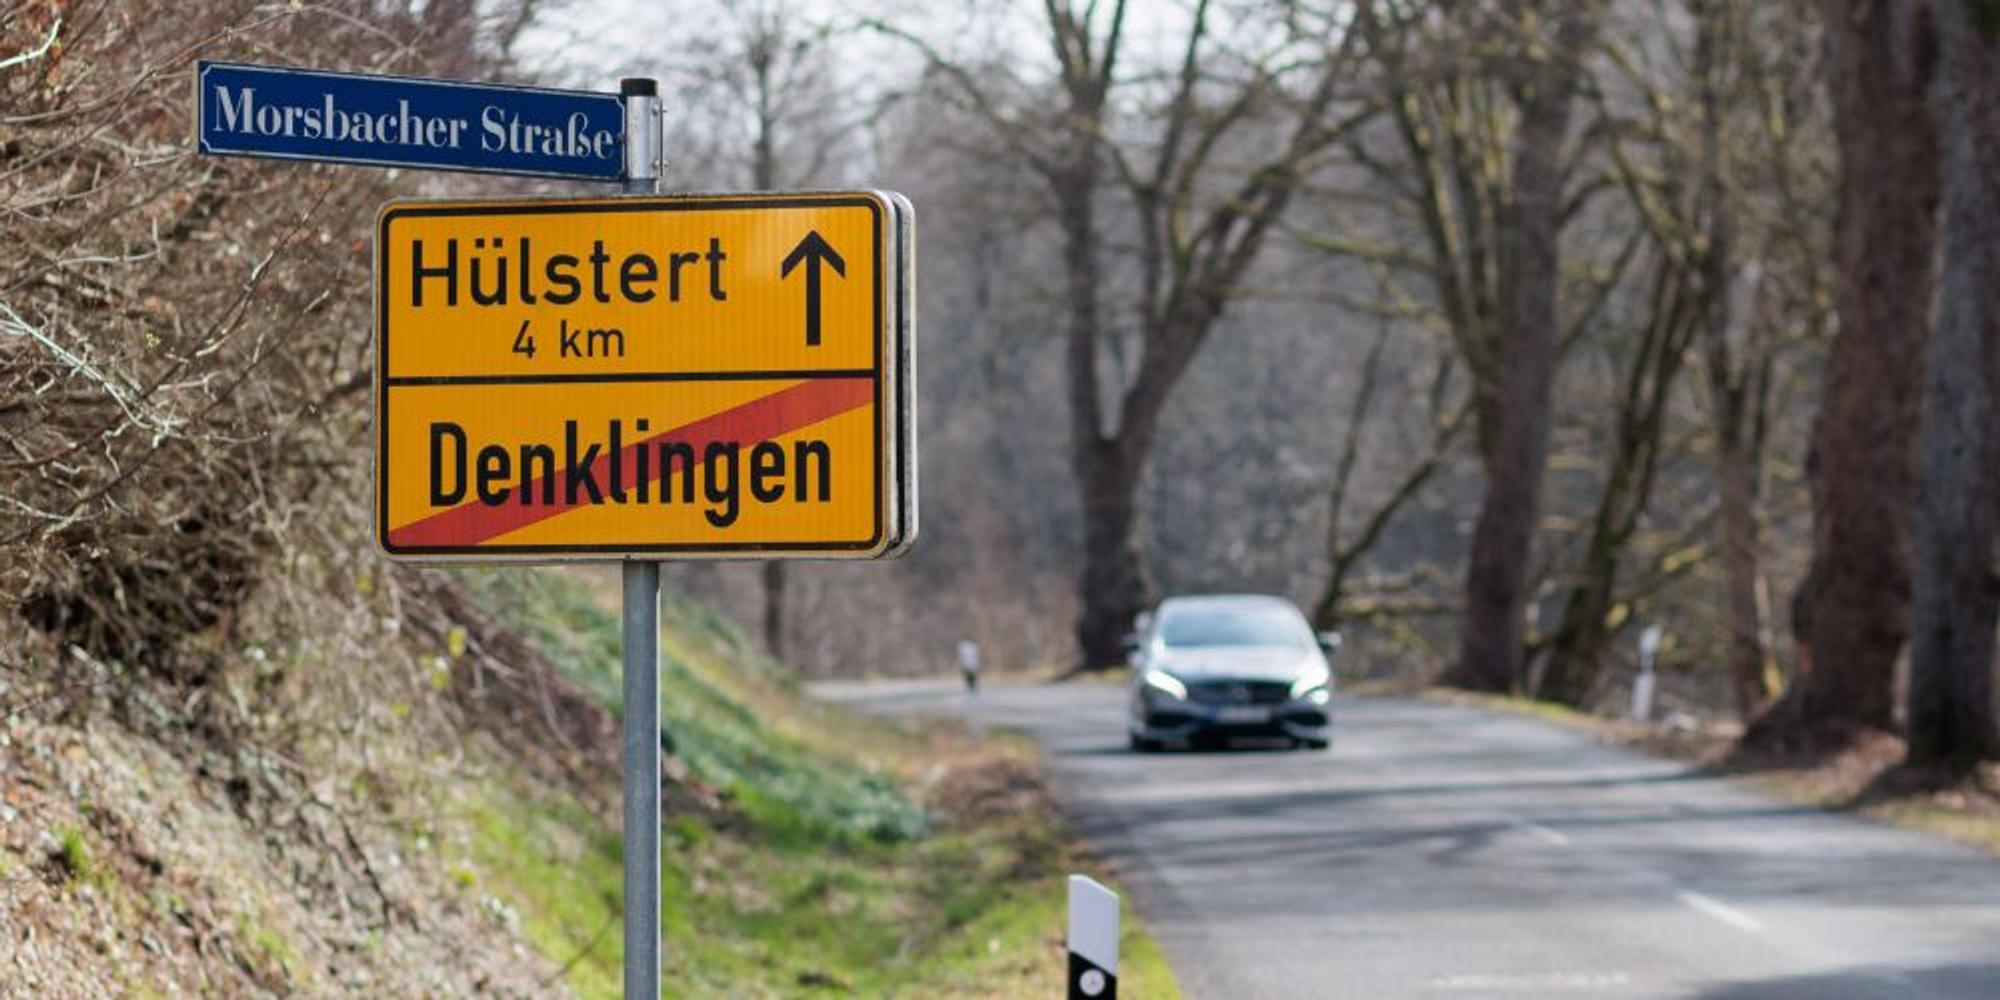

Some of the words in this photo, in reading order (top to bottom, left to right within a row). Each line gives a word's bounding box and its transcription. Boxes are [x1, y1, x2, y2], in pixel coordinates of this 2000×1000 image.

[212, 85, 468, 149] Morsbacher
[481, 105, 615, 160] Straße
[411, 236, 728, 308] Hülstert
[511, 319, 536, 359] 4
[559, 319, 625, 358] km
[429, 418, 832, 528] Denklingen
